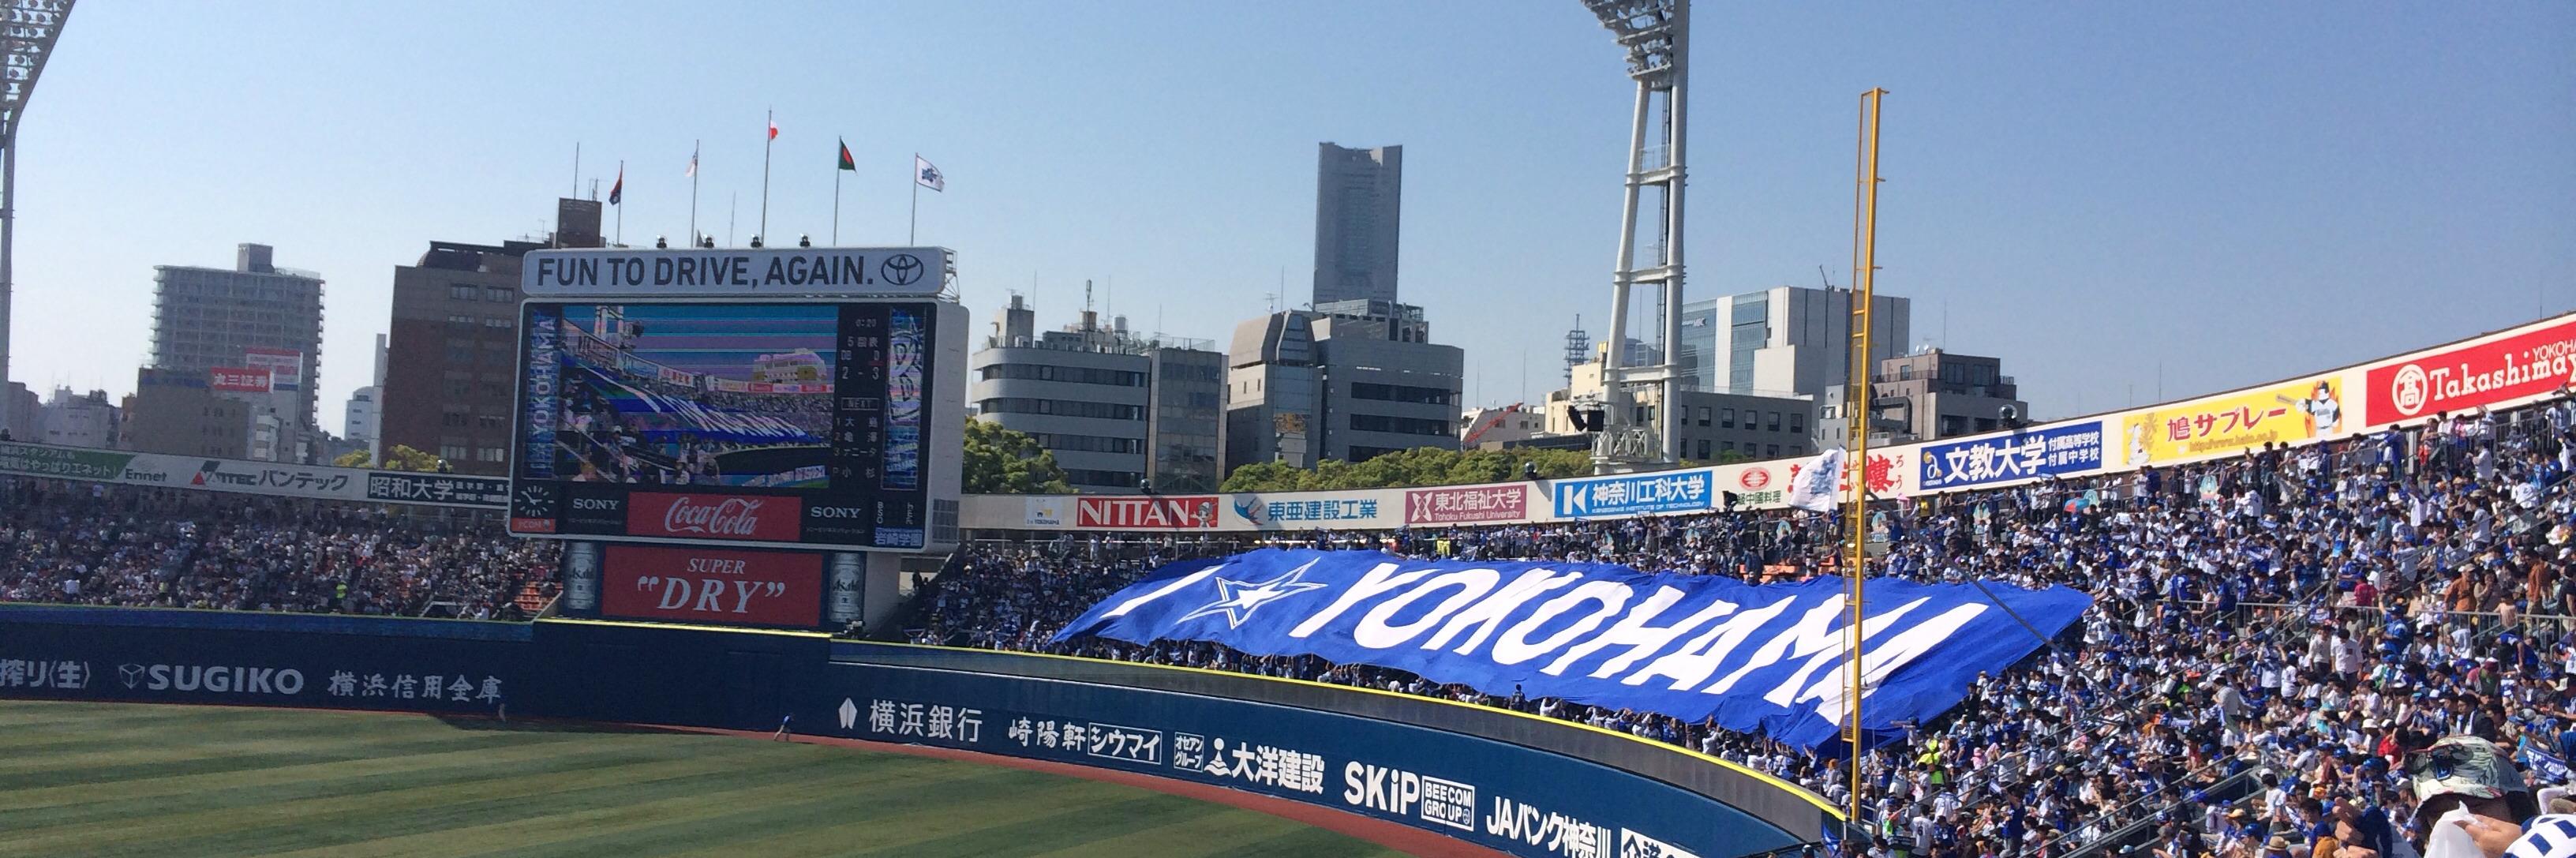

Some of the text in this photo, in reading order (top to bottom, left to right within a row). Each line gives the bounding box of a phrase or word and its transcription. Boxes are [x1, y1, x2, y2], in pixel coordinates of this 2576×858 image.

[537, 256, 874, 289] FUN TO DRIVE, AGAIN.
[872, 367, 879, 380] 3
[2167, 406, 2286, 442] 鳩サブレー
[1944, 435, 2046, 484] 文教大学
[125, 469, 167, 481] Ennet
[259, 470, 349, 491] バンテック
[369, 476, 454, 500] 昭和大学
[1435, 489, 1522, 511] 東北福祉大学
[1593, 475, 1705, 507] 神奈川工科大学
[573, 498, 619, 510] SONY
[665, 496, 765, 535] Coca-Cola
[811, 506, 861, 519] SONY
[1079, 500, 1189, 526] NITTAN
[1268, 499, 1377, 521] 東亜建設工業
[1435, 512, 1458, 521] Tohoku
[687, 557, 746, 575] SUPER
[1100, 562, 1990, 726] I YOKOHAMA
[148, 664, 304, 695] SUGIKO
[328, 669, 503, 704] 横浜信用金庫
[869, 699, 983, 743] 横浜銀行
[1009, 718, 1163, 761] 崎陽軒 シウマイ
[1175, 734, 1204, 751] オセアン
[1174, 751, 1204, 769] グループ
[1231, 742, 1326, 796] 大洋建設
[1424, 801, 1462, 823] GROUP
[1487, 796, 1611, 858] JAバンク神奈川
